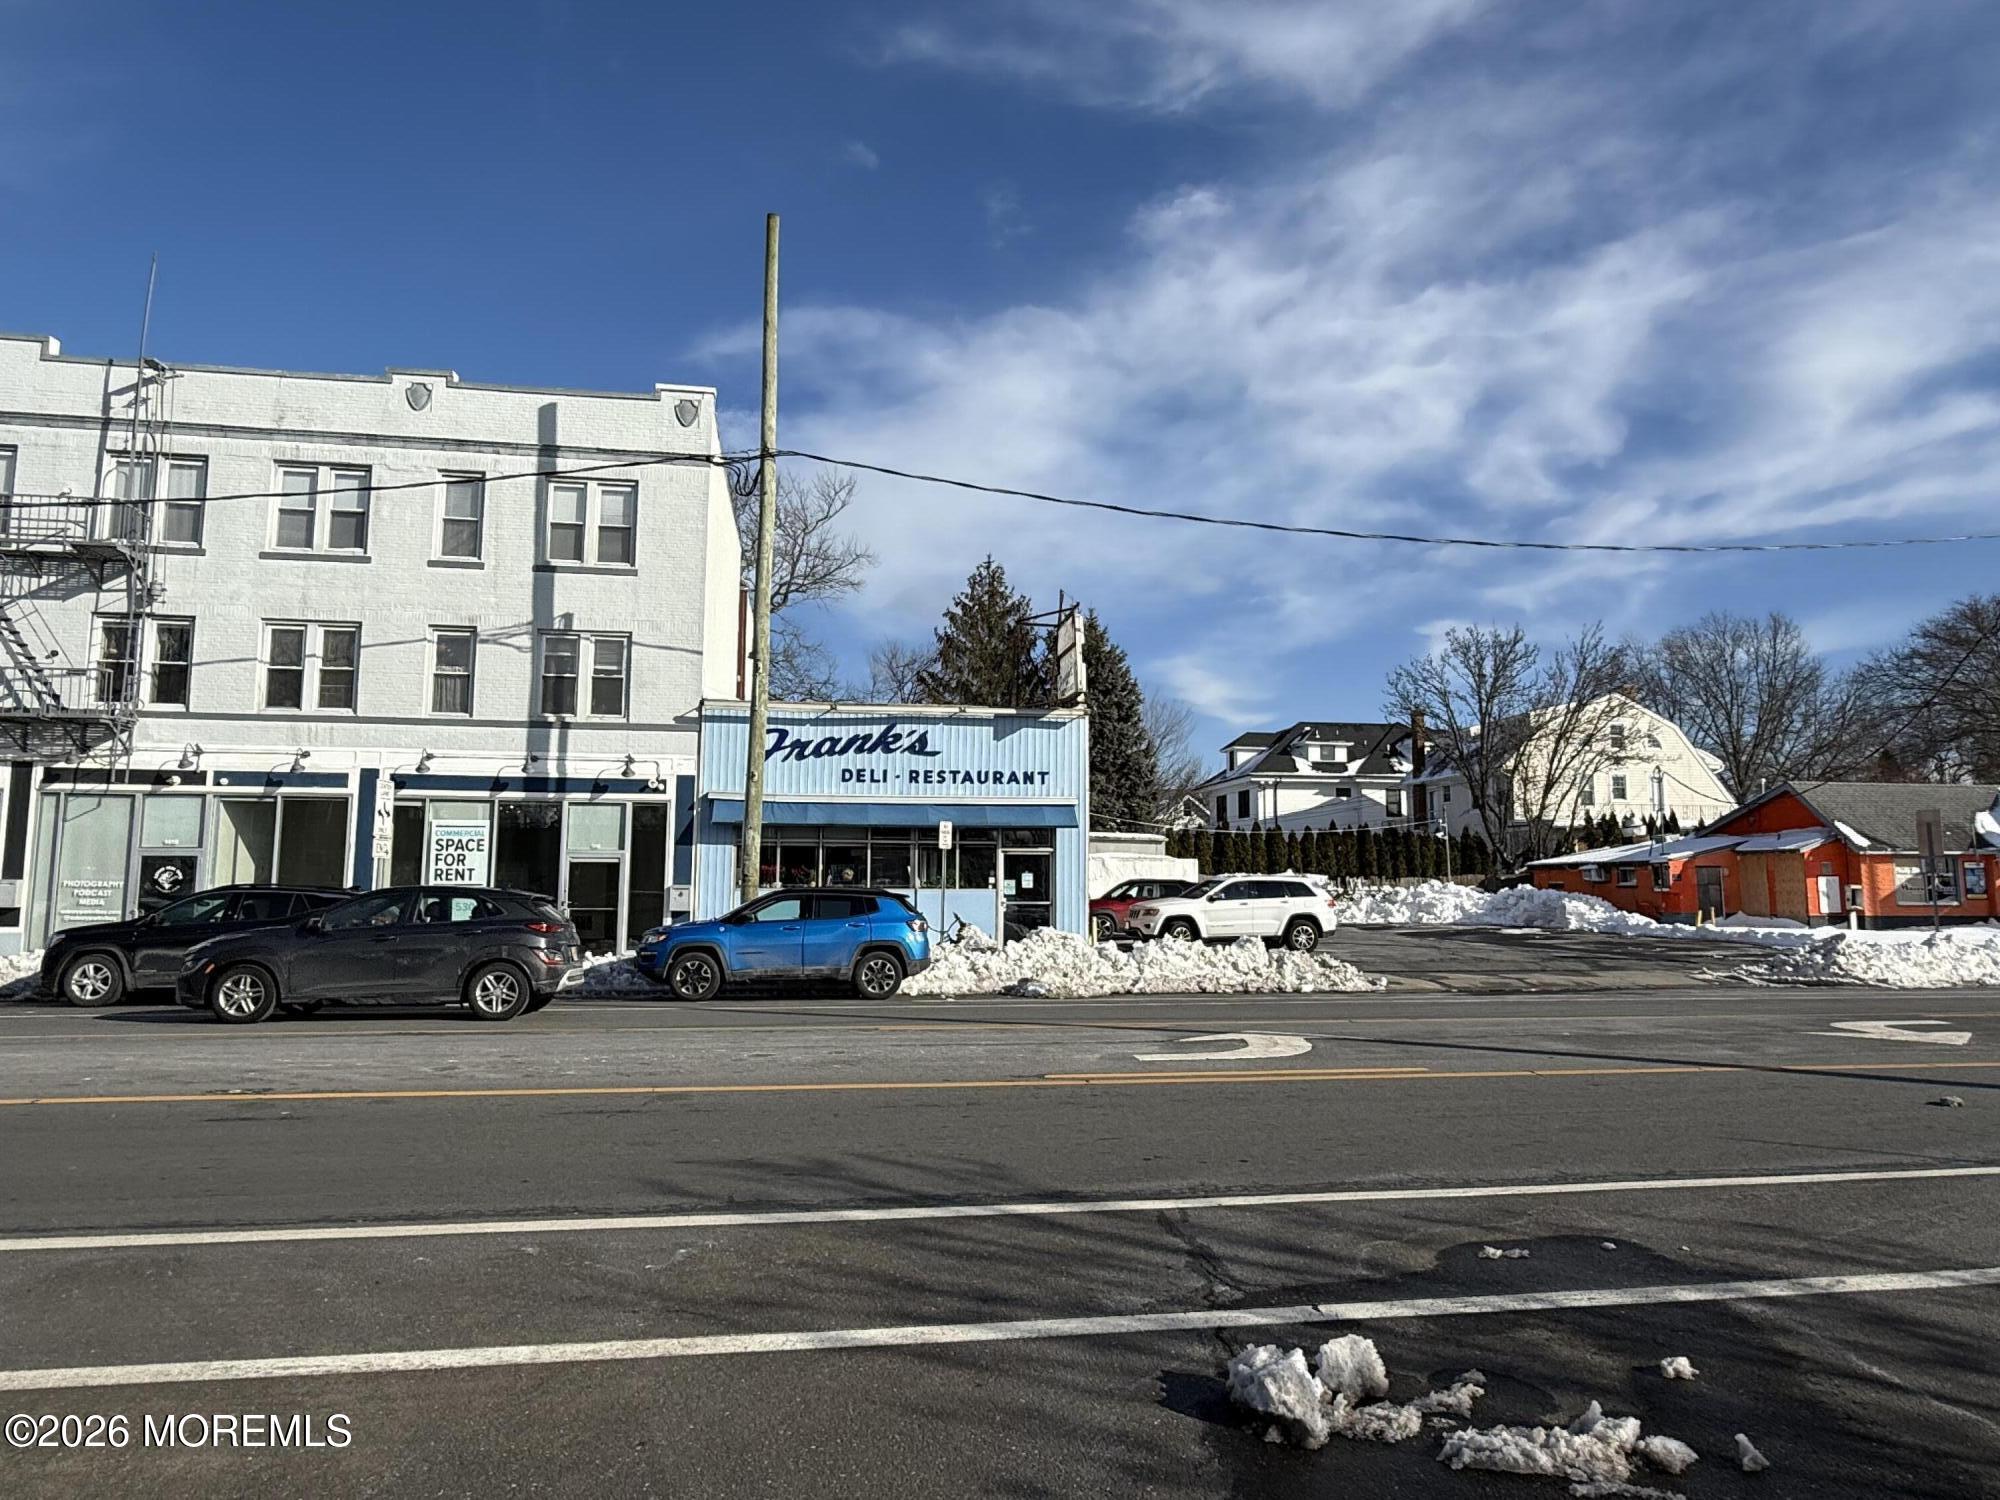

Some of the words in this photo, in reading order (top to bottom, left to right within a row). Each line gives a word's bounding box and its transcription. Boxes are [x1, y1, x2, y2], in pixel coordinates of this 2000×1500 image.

[765, 723, 941, 762] Frank's
[841, 768, 887, 783] DELI
[909, 769, 1049, 785] RESTAURANT
[435, 829, 485, 837] COMMERCIAL
[435, 838, 485, 852] SPACE
[435, 853, 466, 867] FOR
[434, 868, 475, 882] RENT
[63, 880, 124, 888] PHOTOGRAPHY
[73, 889, 112, 897] PODCAST
[78, 898, 105, 906] MEDIA
